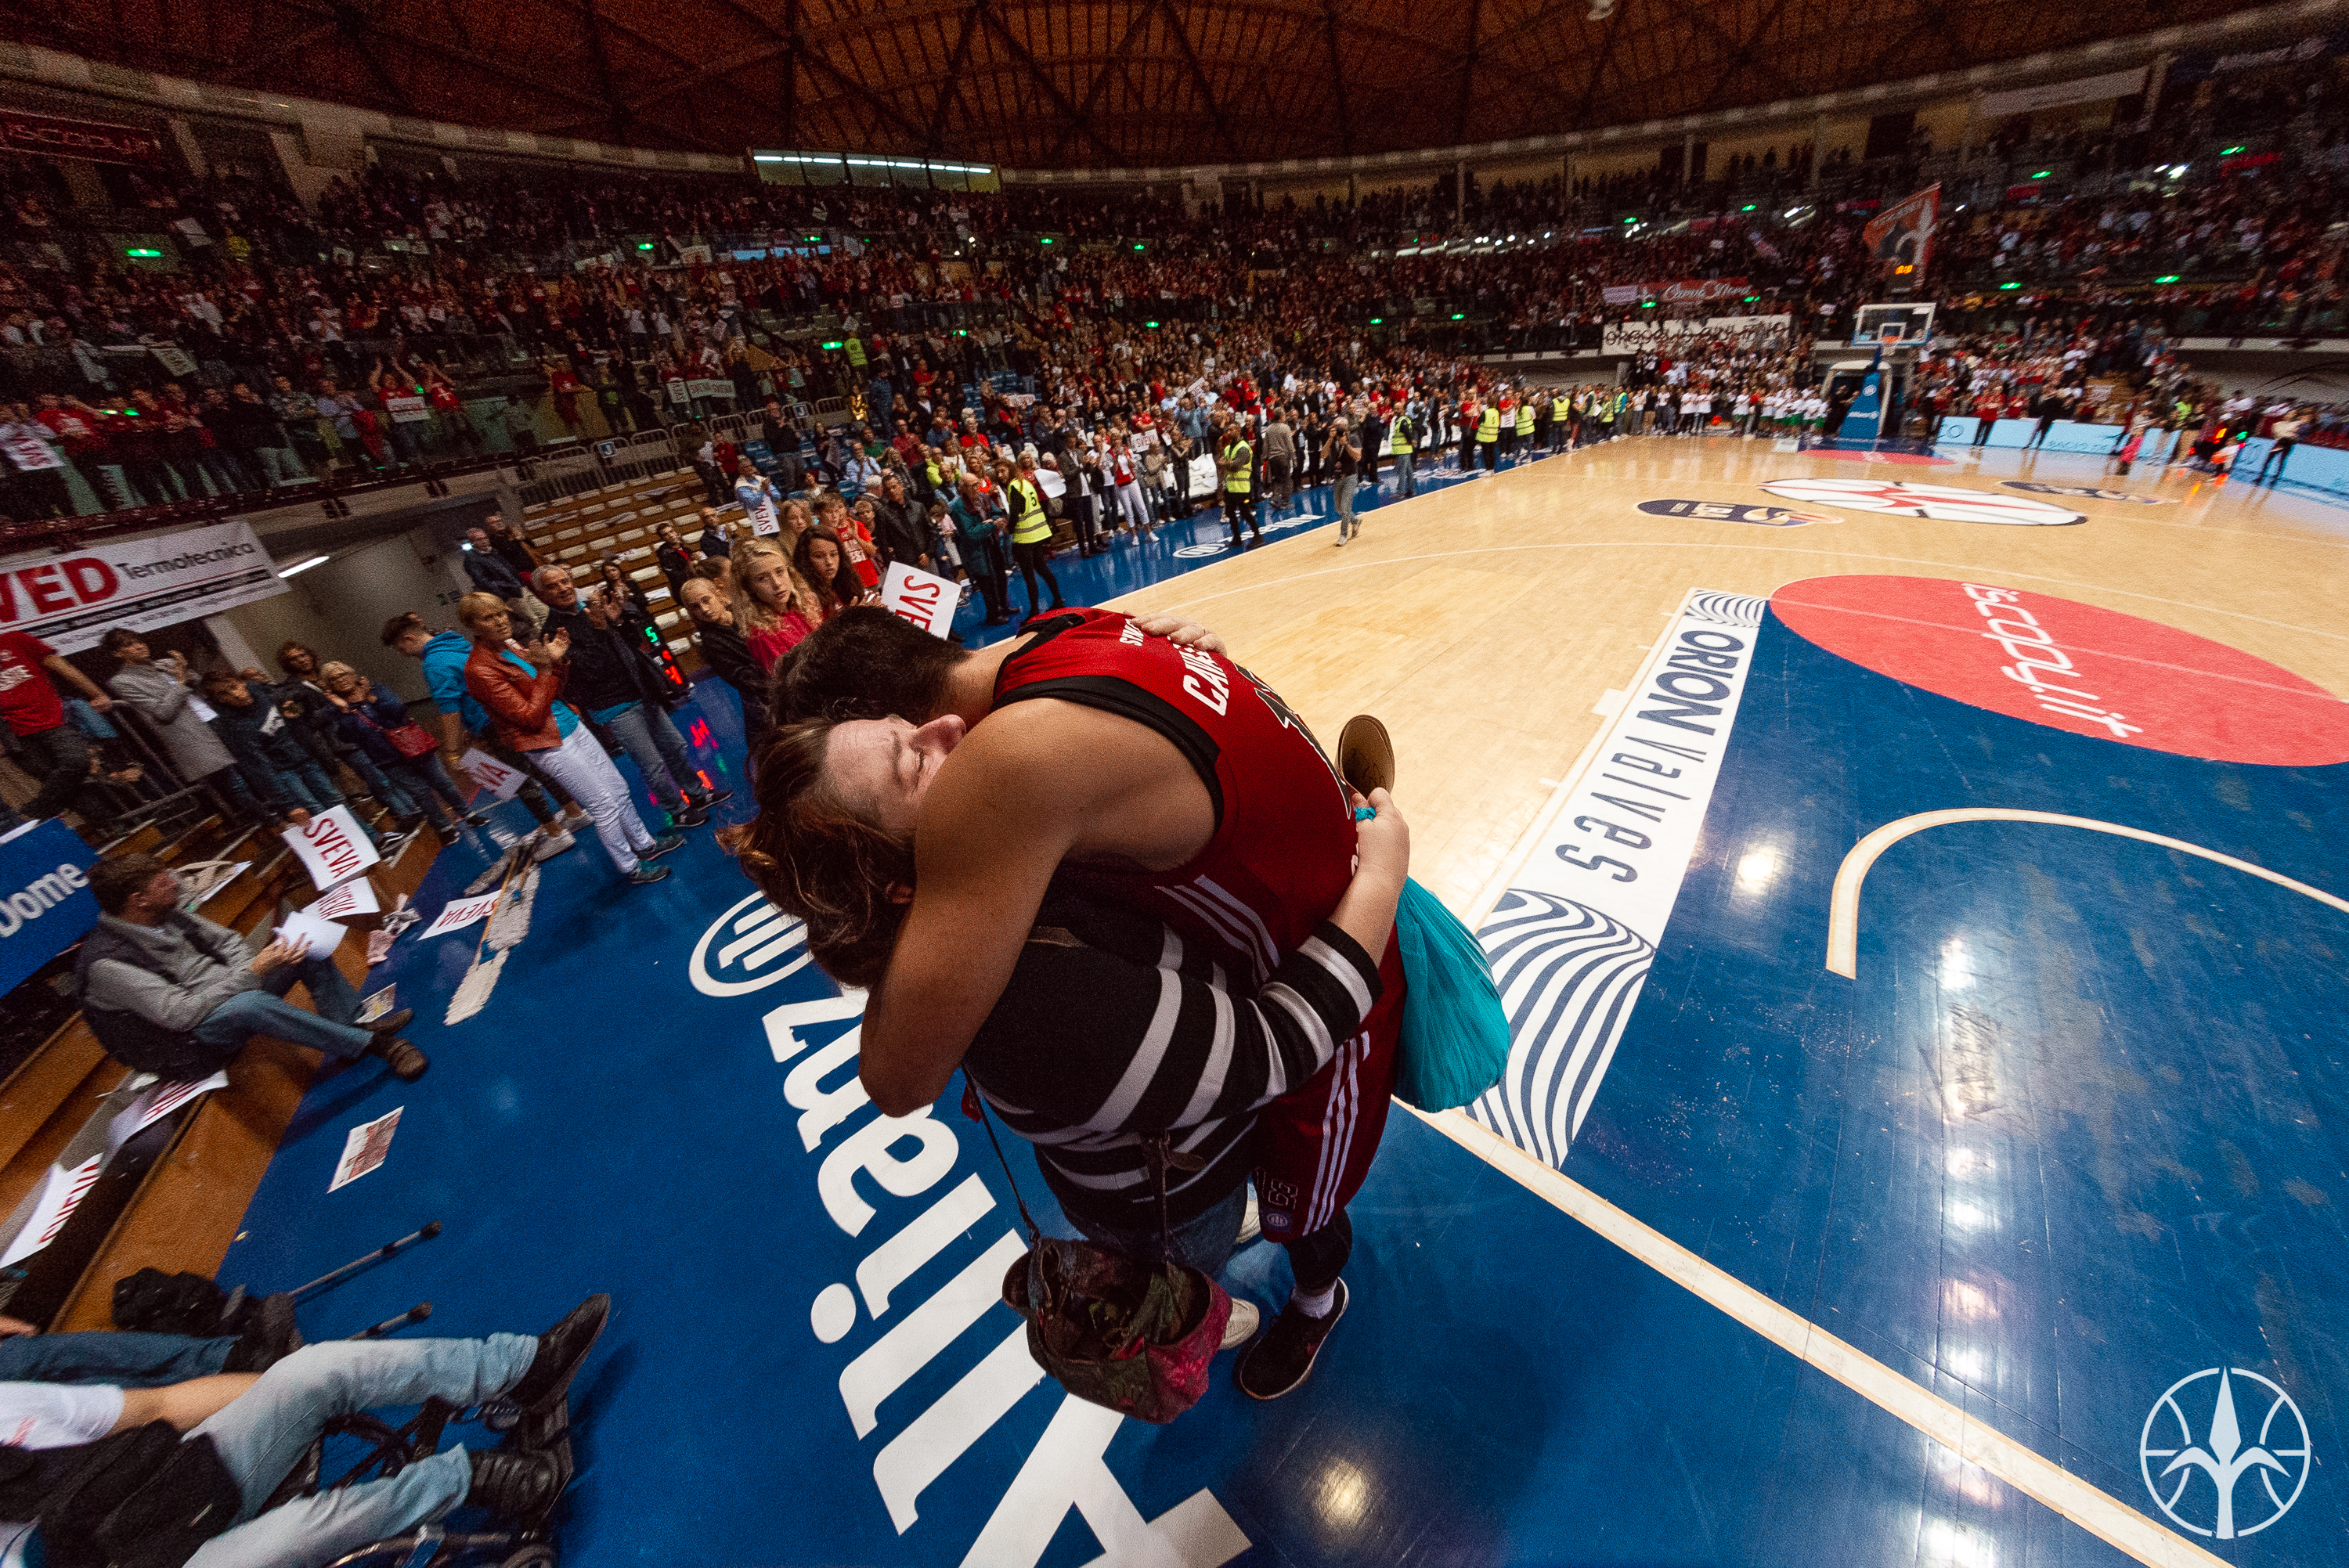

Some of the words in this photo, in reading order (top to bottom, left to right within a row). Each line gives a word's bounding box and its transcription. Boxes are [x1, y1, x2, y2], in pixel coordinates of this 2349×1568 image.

[1030, 492, 1037, 507] 5
[116, 540, 257, 580] Termotecnica
[1633, 629, 1745, 737] ORION
[1960, 582, 2144, 738] iscopy.it
[302, 816, 362, 880] SVEVA
